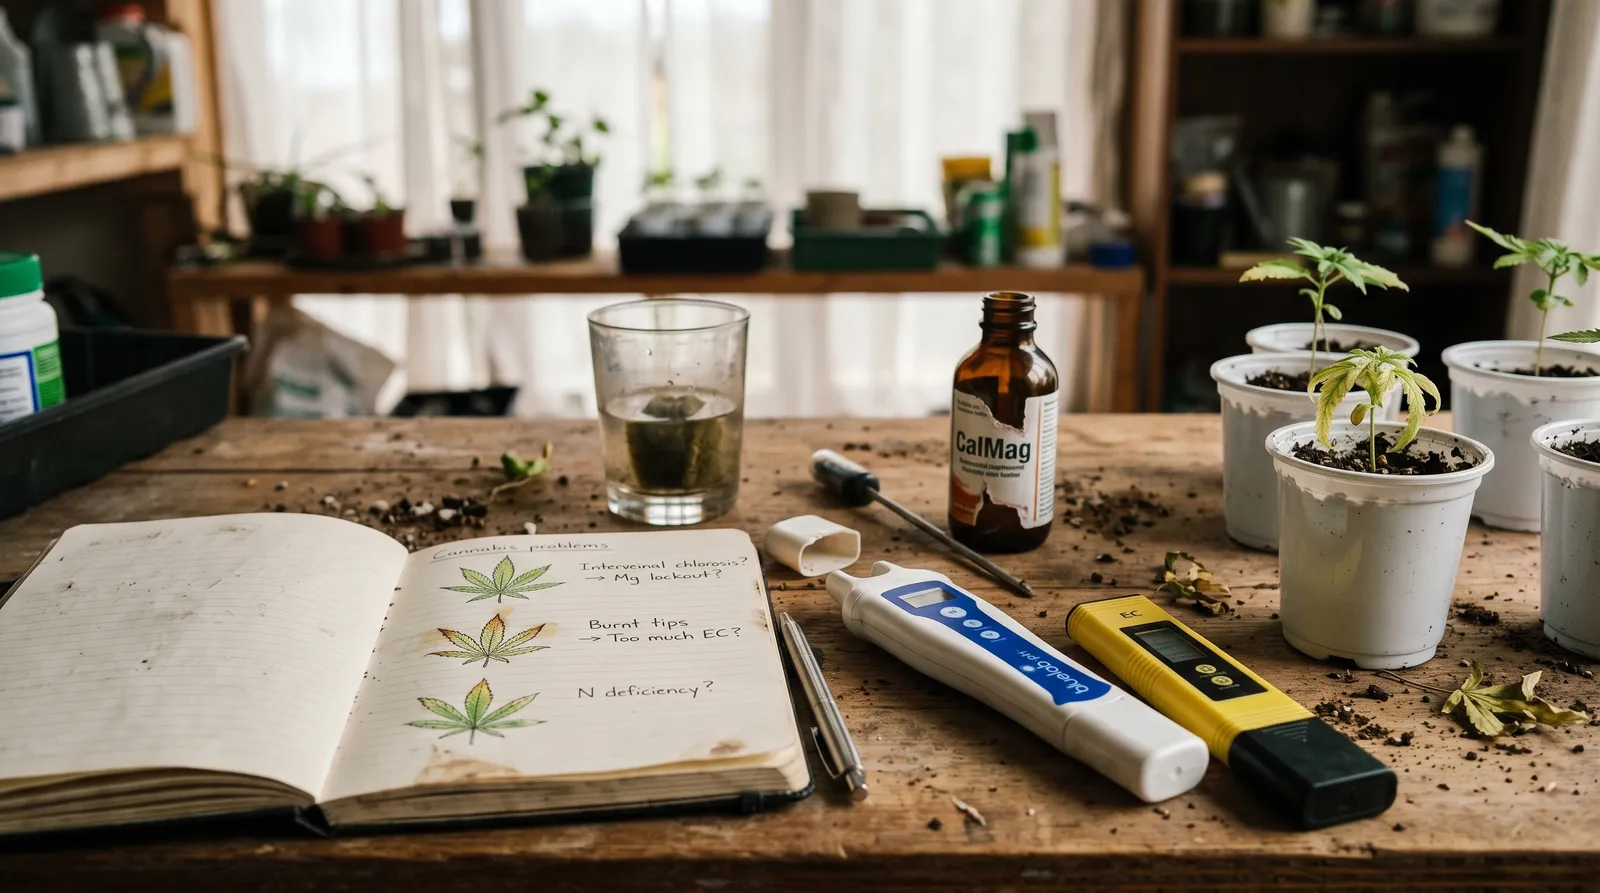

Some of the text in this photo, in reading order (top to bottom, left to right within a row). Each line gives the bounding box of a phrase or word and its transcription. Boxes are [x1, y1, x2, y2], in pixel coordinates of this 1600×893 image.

[956, 430, 1031, 463] CalMag
[432, 541, 609, 560] Cannabis problems
[579, 556, 748, 571] Interveinal chlorosis?
[614, 569, 722, 586] Mg lockout?
[1120, 610, 1144, 619] EC
[589, 617, 689, 631] Burnt tips
[607, 626, 741, 643] Too much EC?
[1036, 660, 1090, 695] bluelab
[578, 680, 714, 699] N deficiency?
